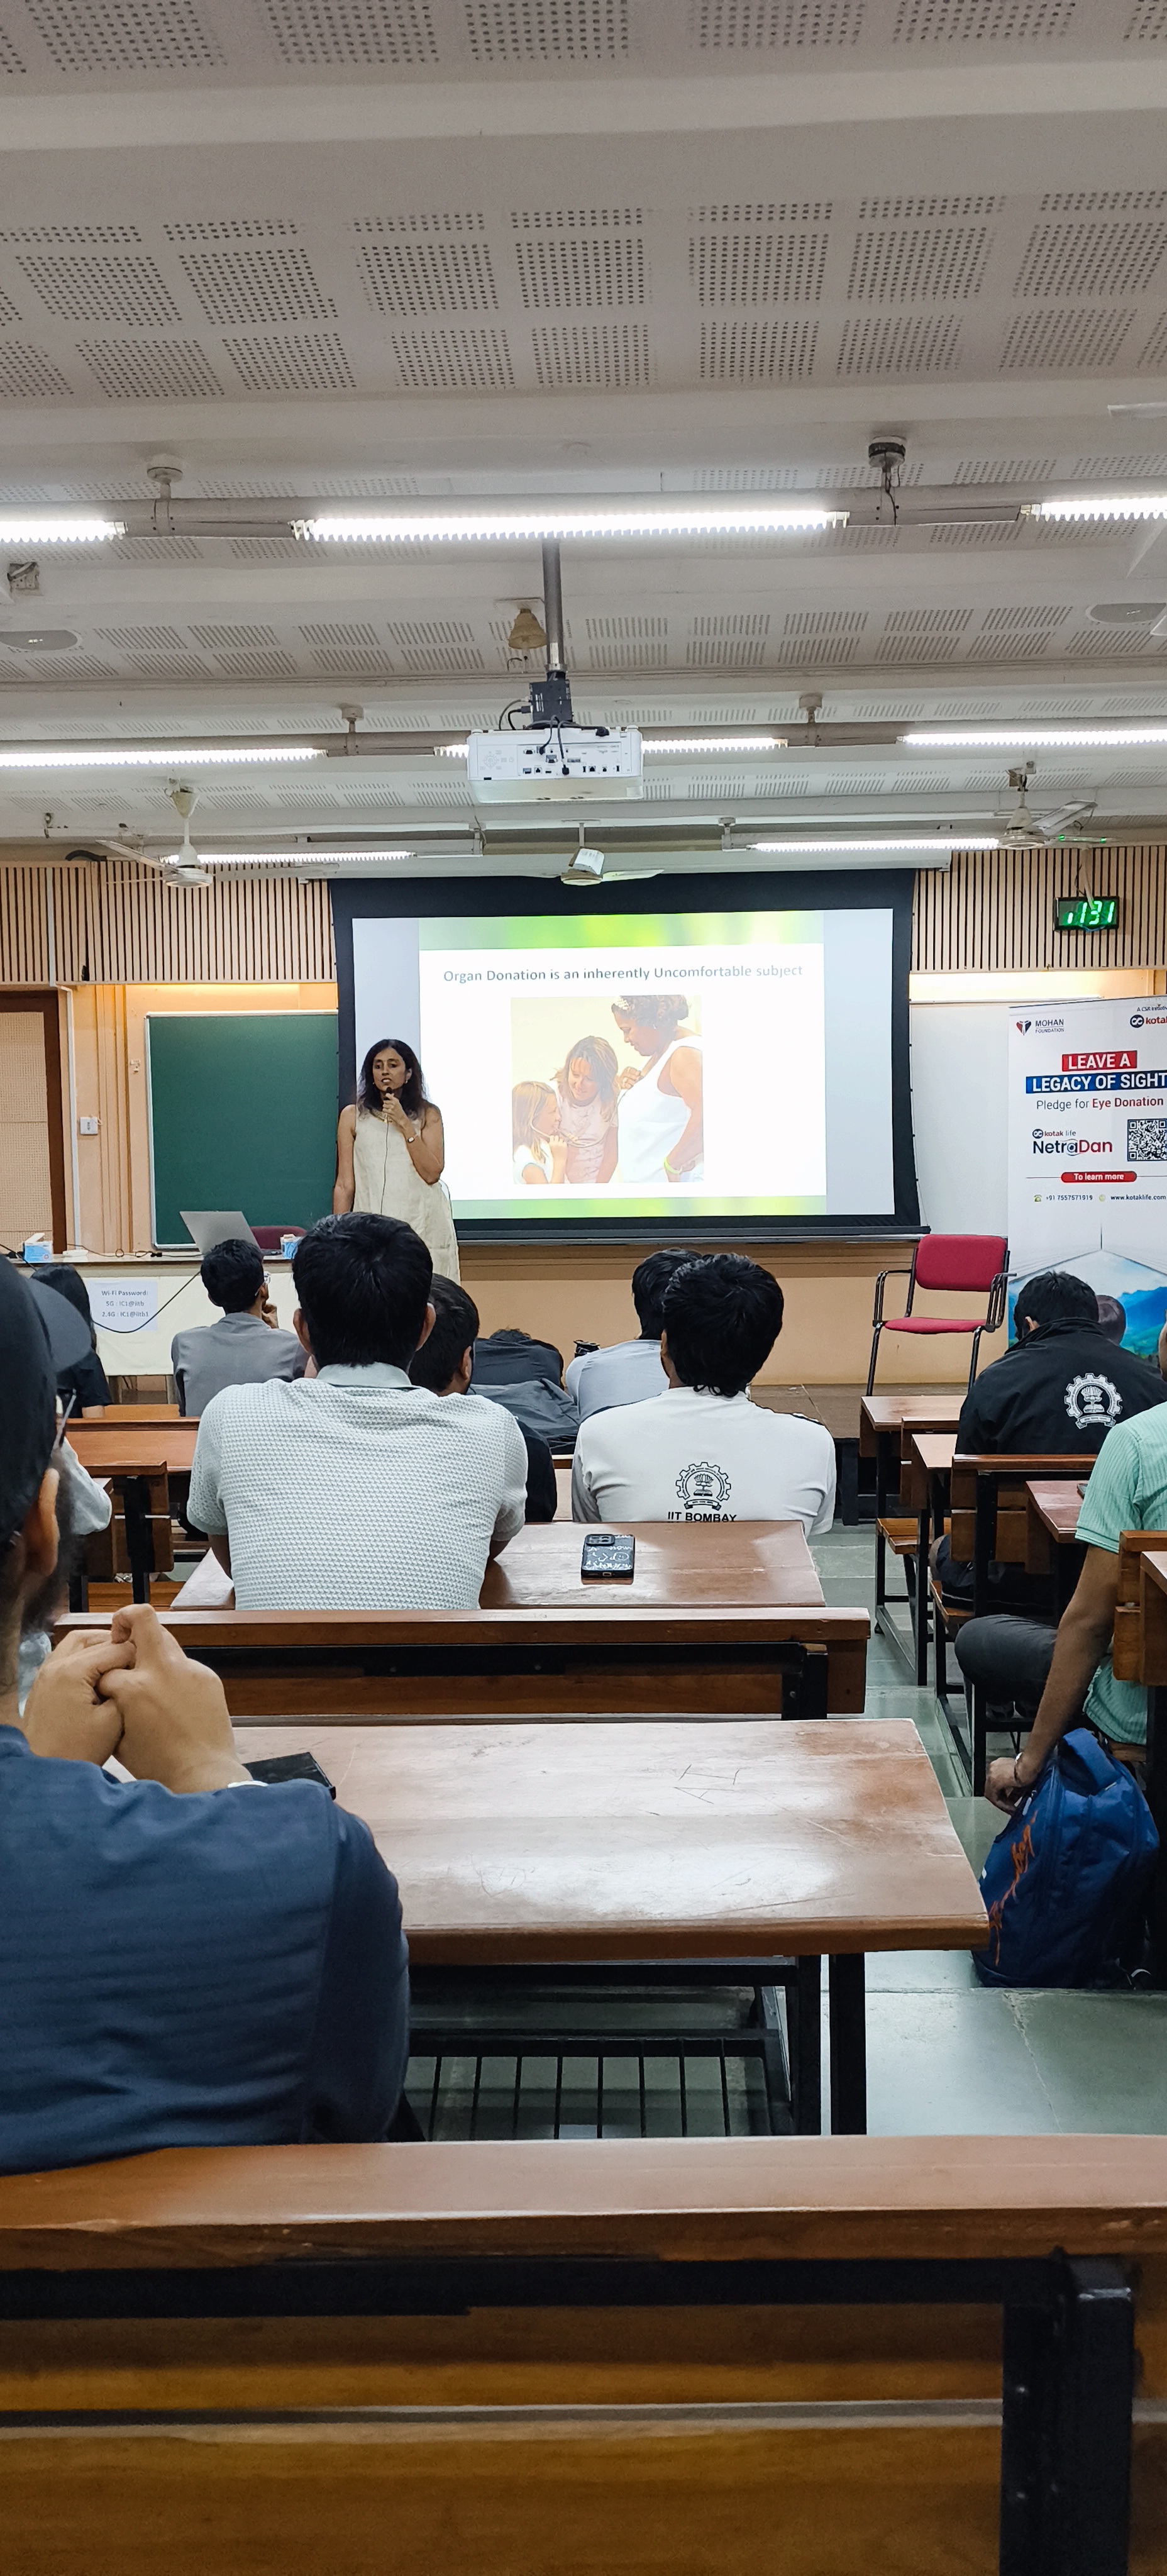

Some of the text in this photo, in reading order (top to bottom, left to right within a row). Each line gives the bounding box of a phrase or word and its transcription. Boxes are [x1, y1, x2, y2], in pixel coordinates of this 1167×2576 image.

[443, 964, 803, 984] Organ Donation is an inherently Uncomfortable subject
[1035, 1019, 1064, 1027] MOHAN
[1145, 1016, 1167, 1024] kota
[1068, 1053, 1131, 1070] LEAVE A
[1032, 1072, 1167, 1092] LEGACY OF SIGHT
[1036, 1096, 1164, 1112] Pledge for Eye Donation
[1033, 1139, 1113, 1155] NetraDan
[1085, 1172, 1103, 1180] learn
[668, 1511, 737, 1523] IIT BOMBAY
